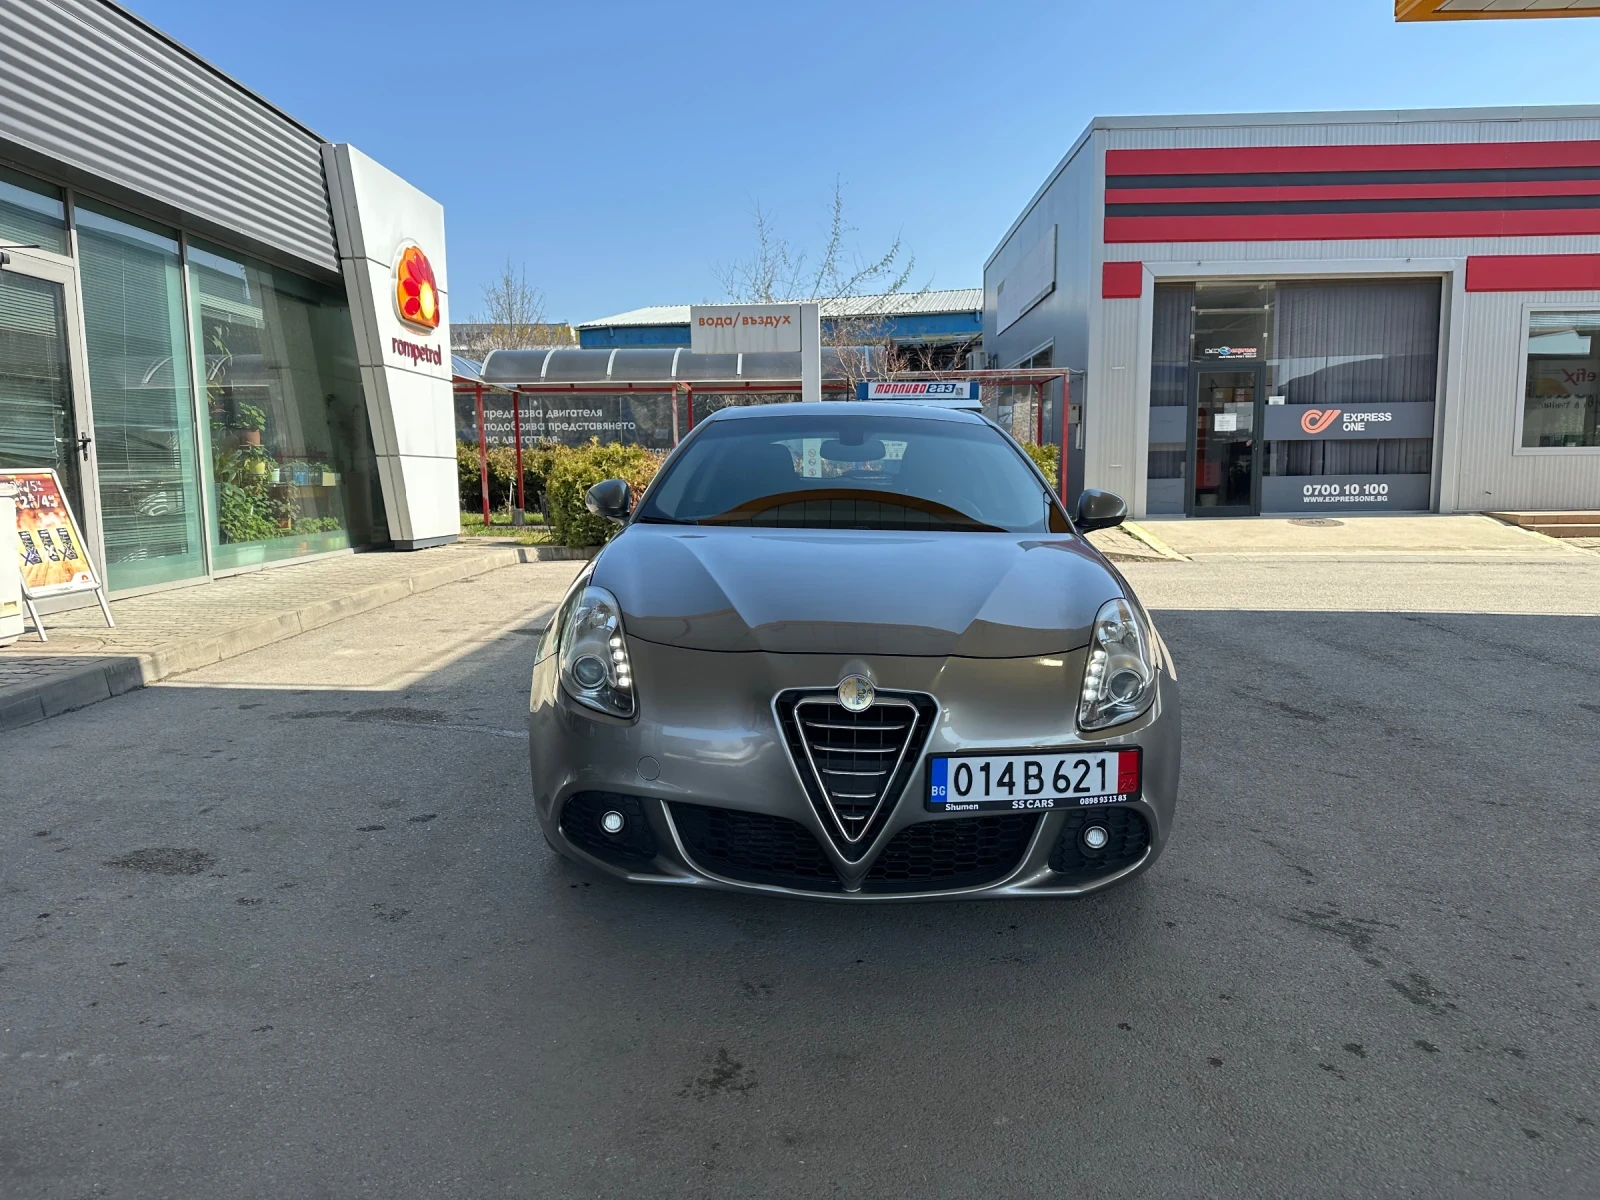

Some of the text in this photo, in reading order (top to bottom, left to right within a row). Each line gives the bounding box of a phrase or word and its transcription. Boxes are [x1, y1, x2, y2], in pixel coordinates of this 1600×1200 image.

[391, 337, 442, 367] rompetrol
[545, 409, 603, 418] двигателя
[1343, 412, 1393, 422] EXPRESS
[548, 422, 636, 433] представянето
[1342, 422, 1366, 431] ONE
[1303, 483, 1389, 496] 0700 10 100
[1303, 495, 1388, 503] WWW.EXPRESSONE.BG
[931, 785, 946, 797] BG
[1012, 799, 1054, 809] SS CARS
[1079, 796, 1099, 805] 0898
[945, 803, 979, 811] Shumen
